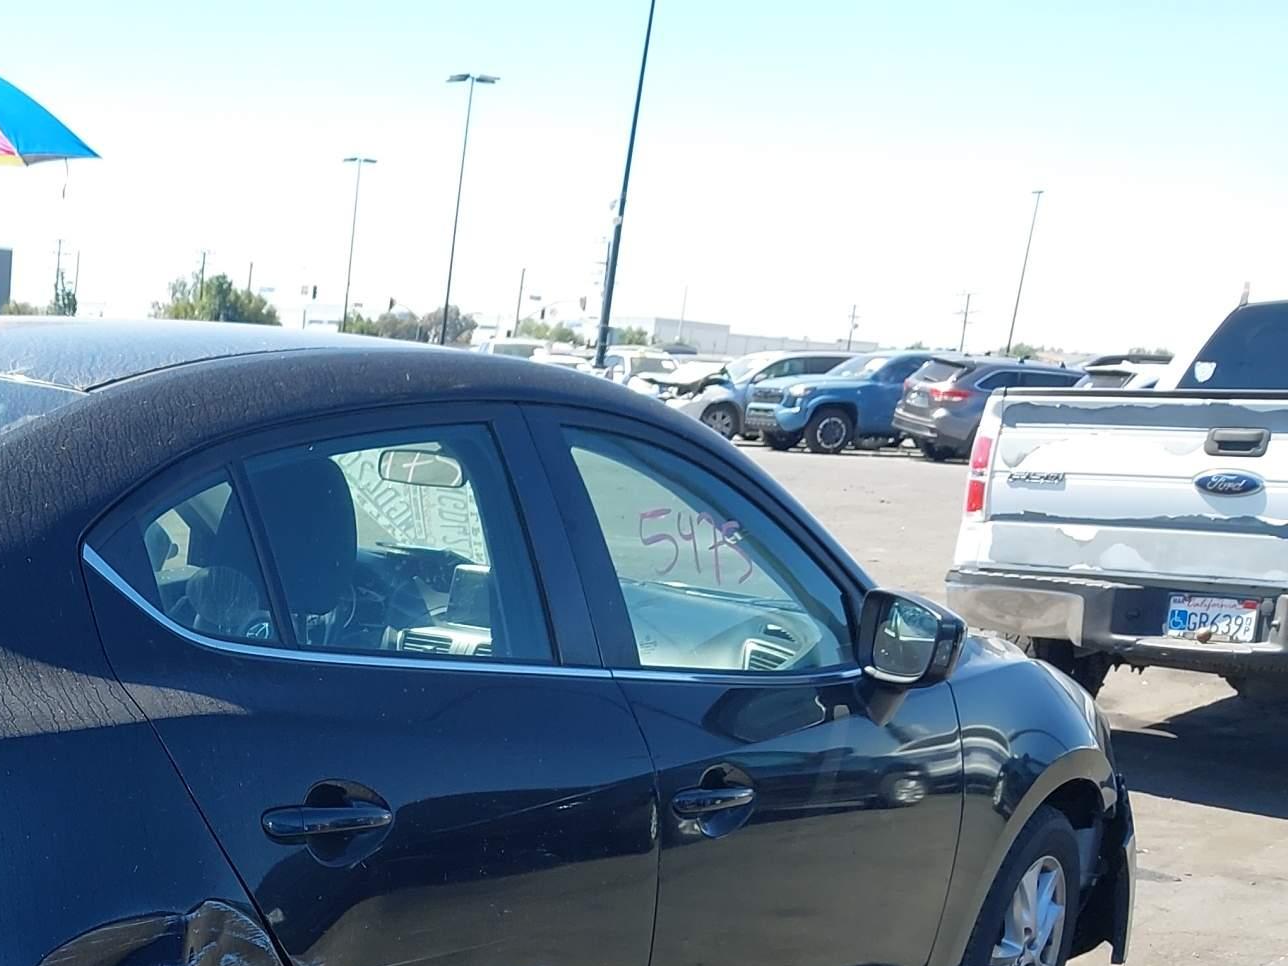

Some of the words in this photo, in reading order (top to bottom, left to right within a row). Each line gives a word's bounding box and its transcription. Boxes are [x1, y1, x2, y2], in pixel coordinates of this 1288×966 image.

[1206, 472, 1246, 492] Ford
[640, 508, 753, 586] 5475
[1185, 597, 1239, 611] California
